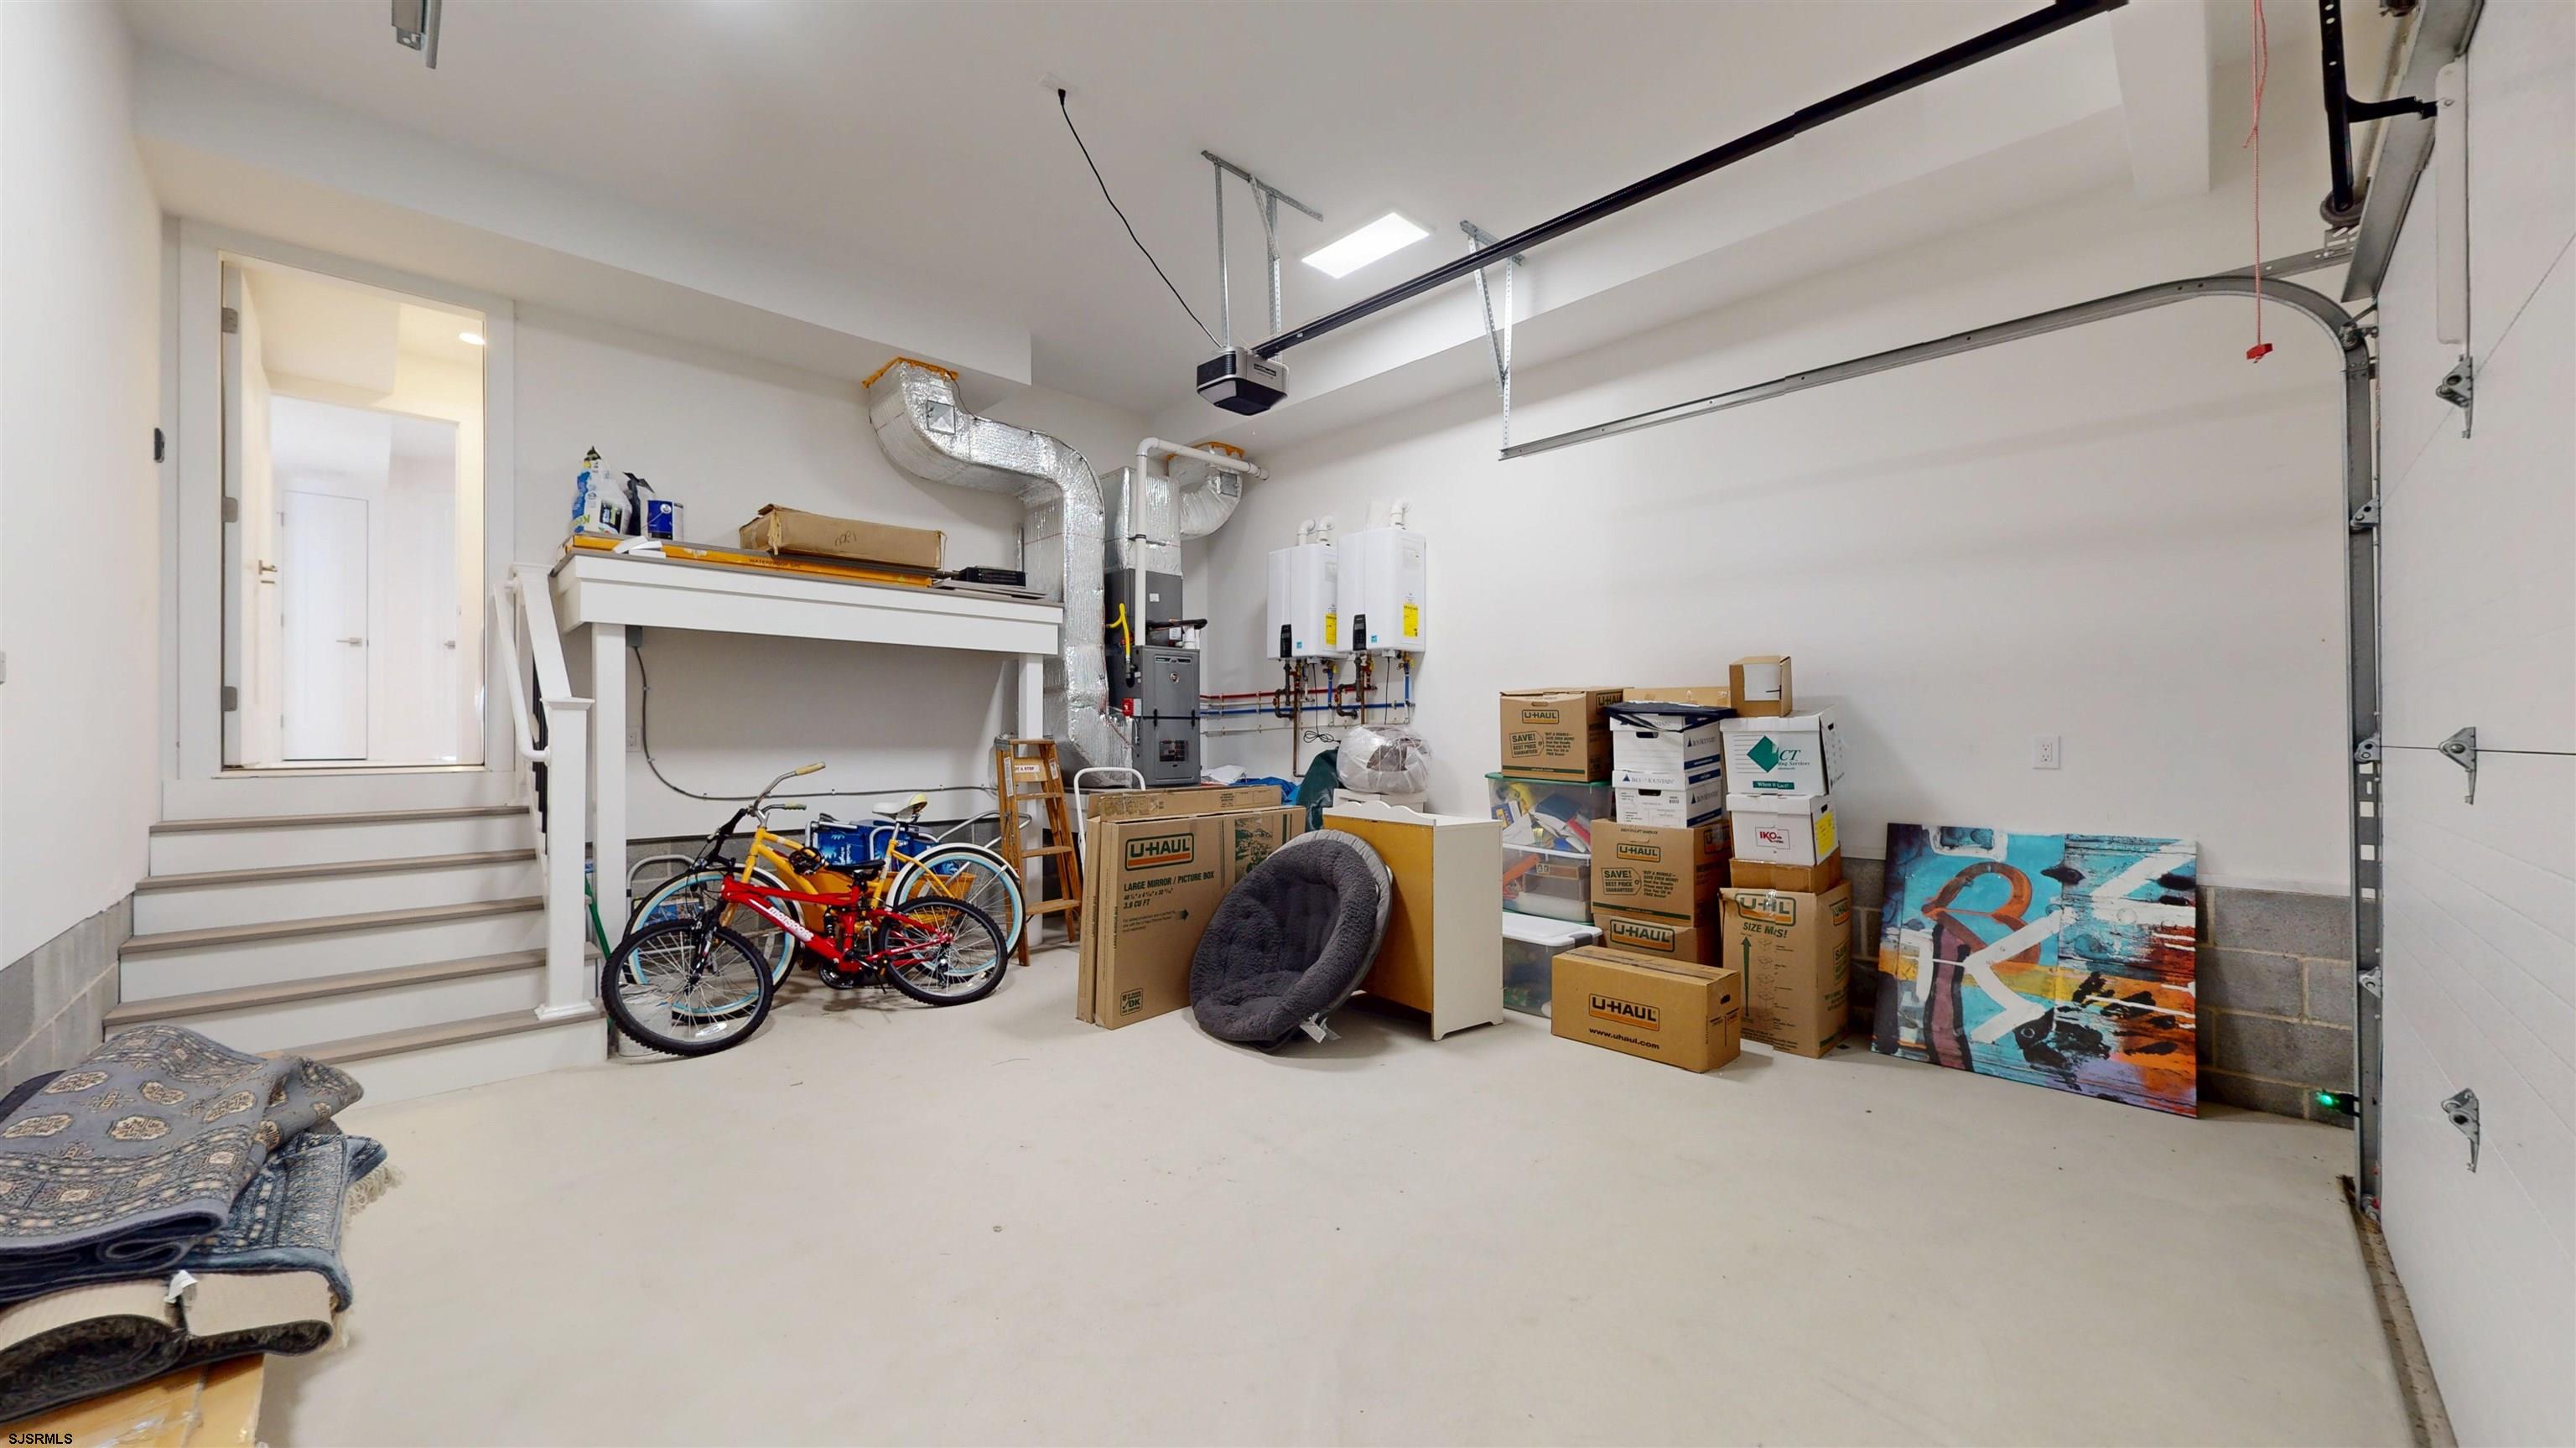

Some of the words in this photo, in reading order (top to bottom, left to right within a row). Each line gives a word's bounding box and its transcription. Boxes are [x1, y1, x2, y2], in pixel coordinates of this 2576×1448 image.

[1512, 733, 1536, 743] SAVE!
[1759, 831, 1778, 840] IKO
[1130, 838, 1191, 858] U-HAUL
[1619, 845, 1658, 857] U-HAUL
[1604, 869, 1632, 879] SAVE!
[1124, 880, 1145, 892] LARGE
[1147, 877, 1171, 888] MIRROR
[1177, 872, 1202, 884] PICTURE
[1203, 870, 1214, 880] BOX
[1134, 899, 1142, 908] CU
[1143, 898, 1150, 906] FT
[1613, 923, 1670, 942] U-HAUL
[1742, 921, 1762, 933] SIZE
[1592, 996, 1657, 1022] U-HAUL
[1589, 1027, 1659, 1050] www.uhaul.com
